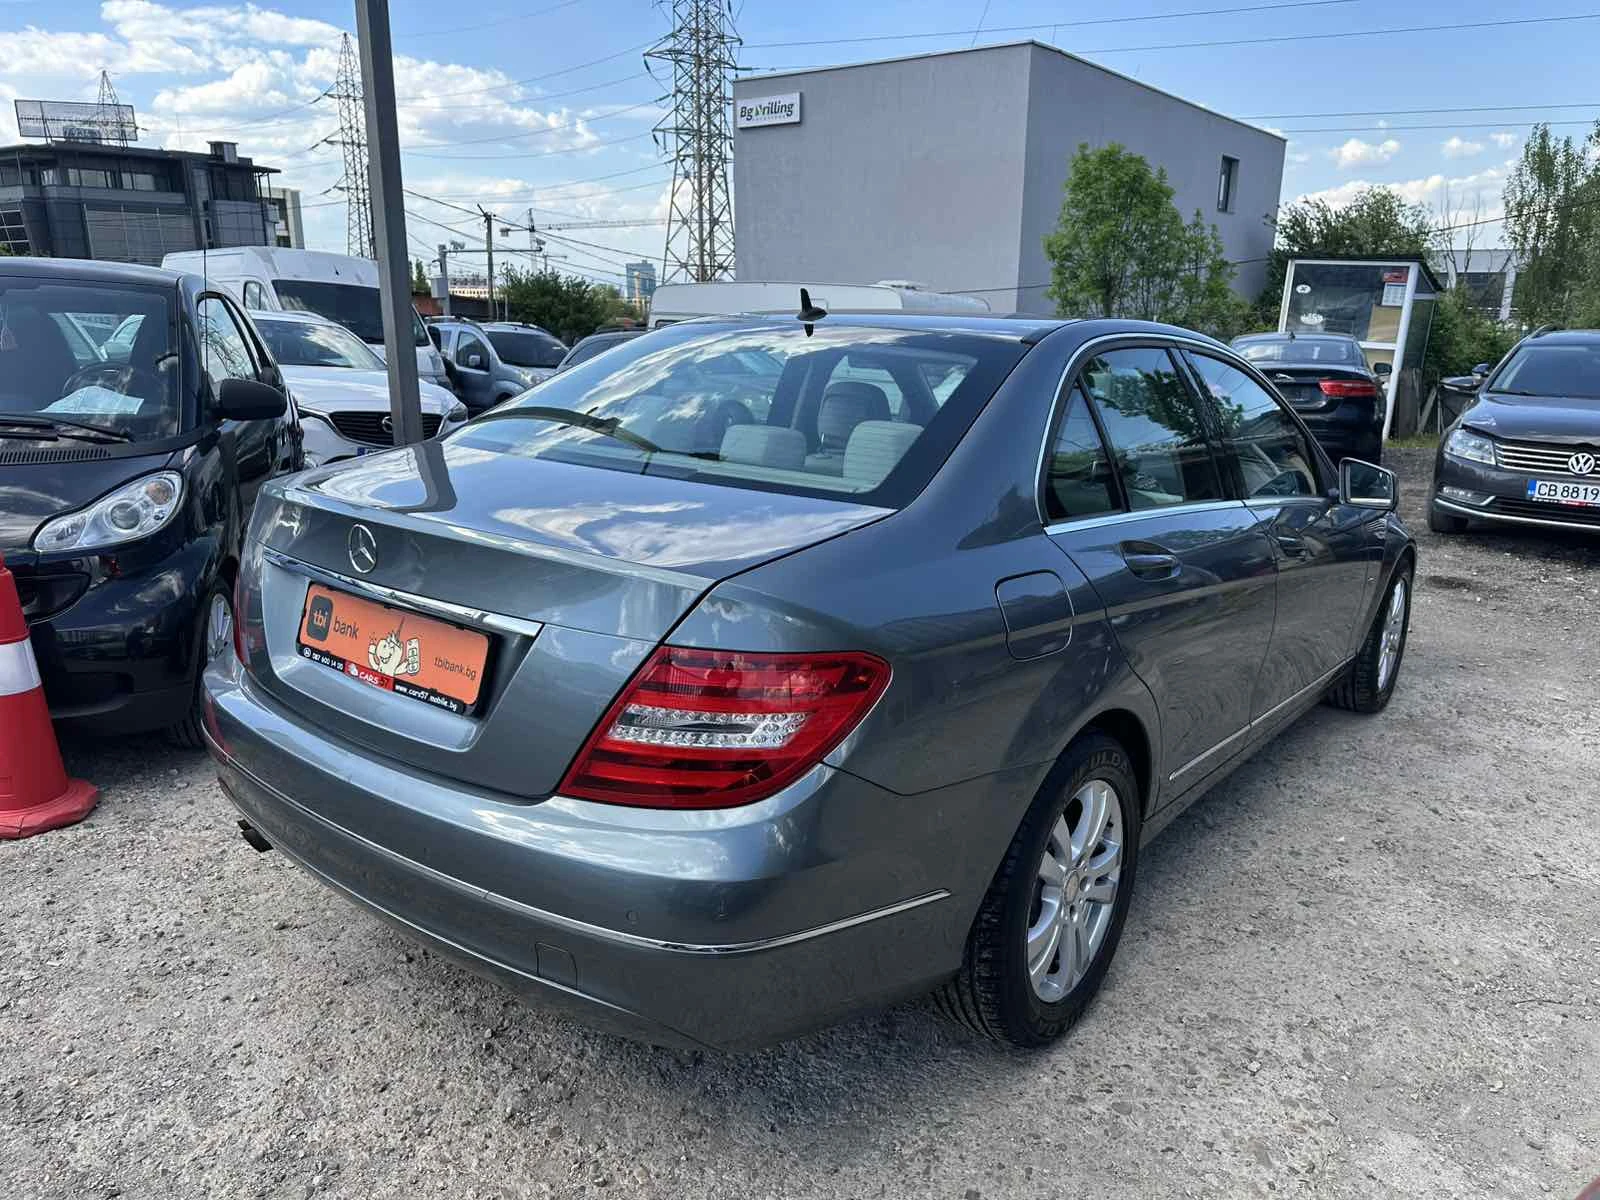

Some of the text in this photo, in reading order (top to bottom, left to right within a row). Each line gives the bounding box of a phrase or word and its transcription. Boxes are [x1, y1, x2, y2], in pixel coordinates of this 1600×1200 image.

[1537, 483, 1600, 501] CB 8819
[313, 609, 360, 640] tbi bank
[433, 656, 477, 681] tbibank.bg
